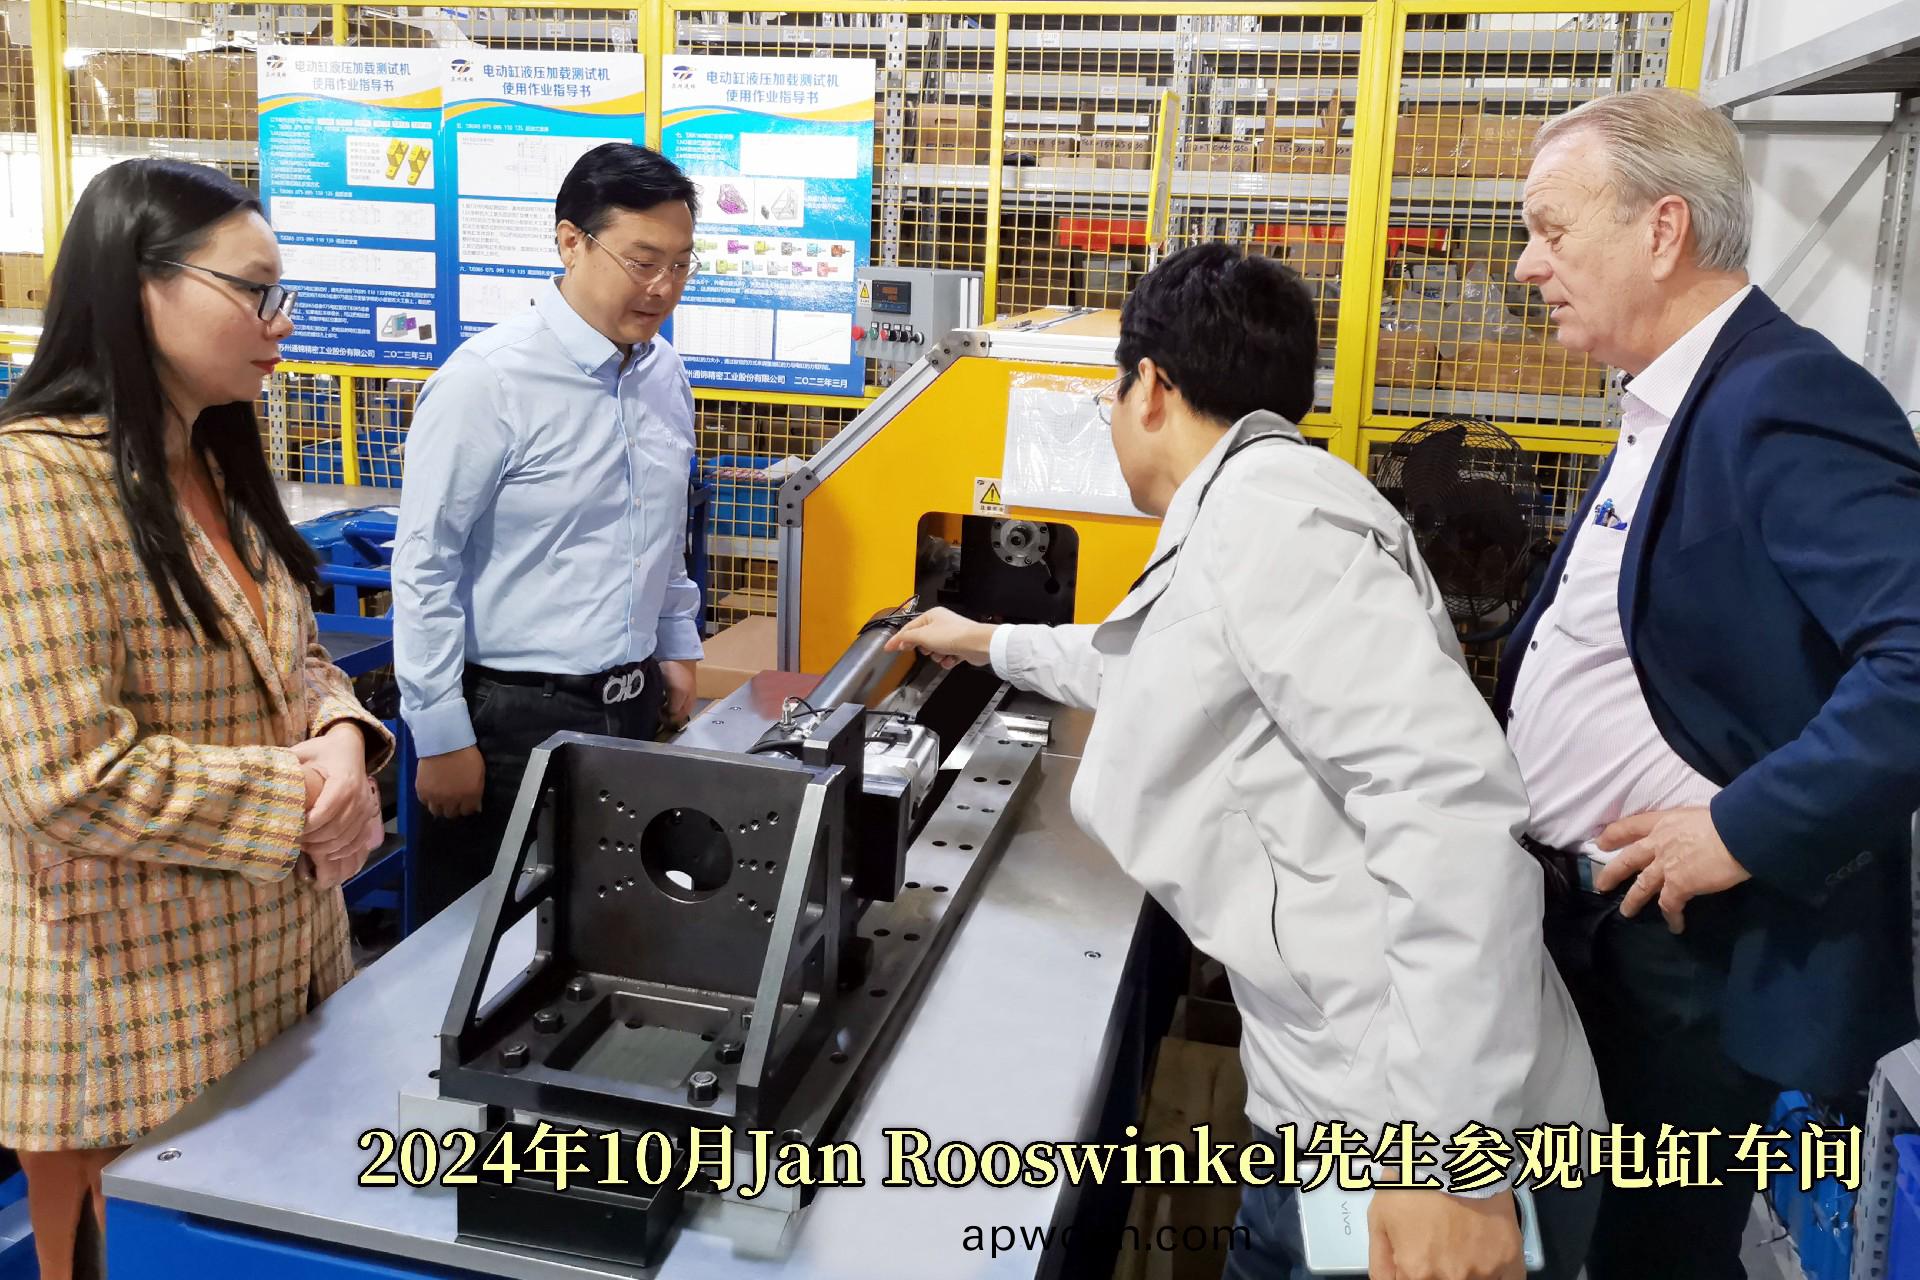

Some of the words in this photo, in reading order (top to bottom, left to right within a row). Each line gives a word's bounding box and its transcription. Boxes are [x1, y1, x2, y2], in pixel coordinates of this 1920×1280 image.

[295, 61, 411, 76] 电动缸液压加载测试机
[483, 64, 611, 81] 电动缸液压加载测试机
[312, 77, 395, 92] 使用作业指导书
[706, 70, 840, 87] 电动缸液压加载测试机
[502, 83, 592, 98] 使用作业指导书
[725, 89, 819, 104] 使用作业指导书
[1340, 1200, 1352, 1236] vivo
